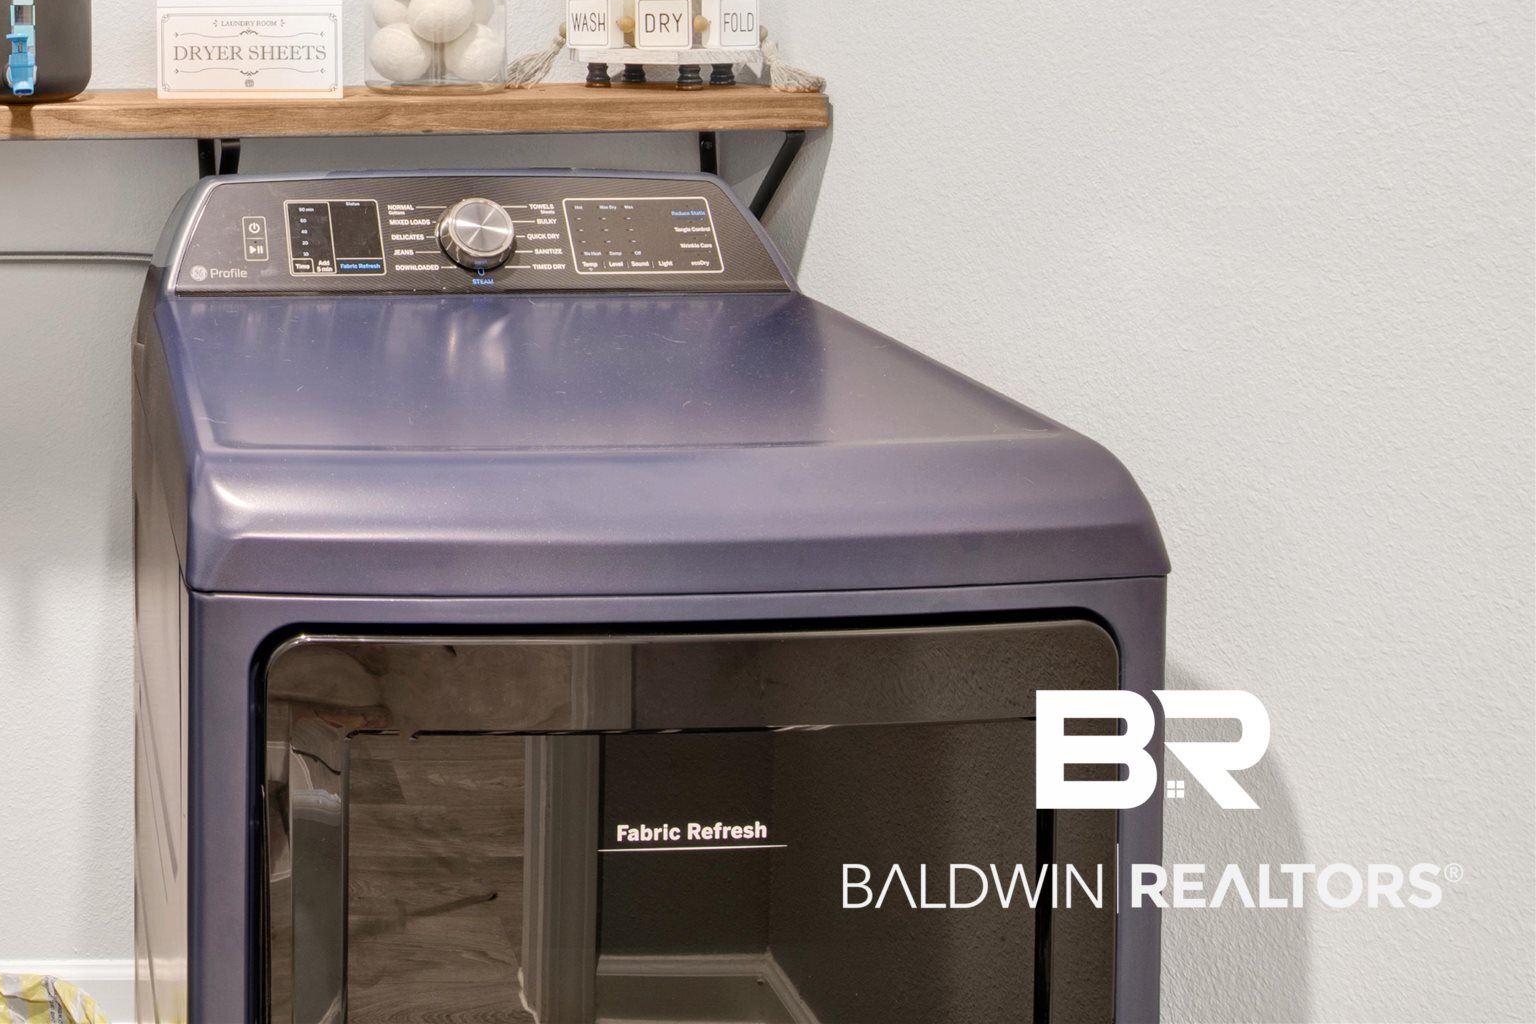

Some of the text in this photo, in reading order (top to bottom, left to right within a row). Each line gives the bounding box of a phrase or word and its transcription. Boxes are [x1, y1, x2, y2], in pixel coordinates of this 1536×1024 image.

[572, 12, 606, 32] WASH
[645, 13, 682, 33] DRY
[723, 12, 754, 32] FOLD
[174, 45, 327, 61] DRYER SHEETS
[210, 268, 247, 278] Profile
[617, 821, 767, 842] Fabric Refresh
